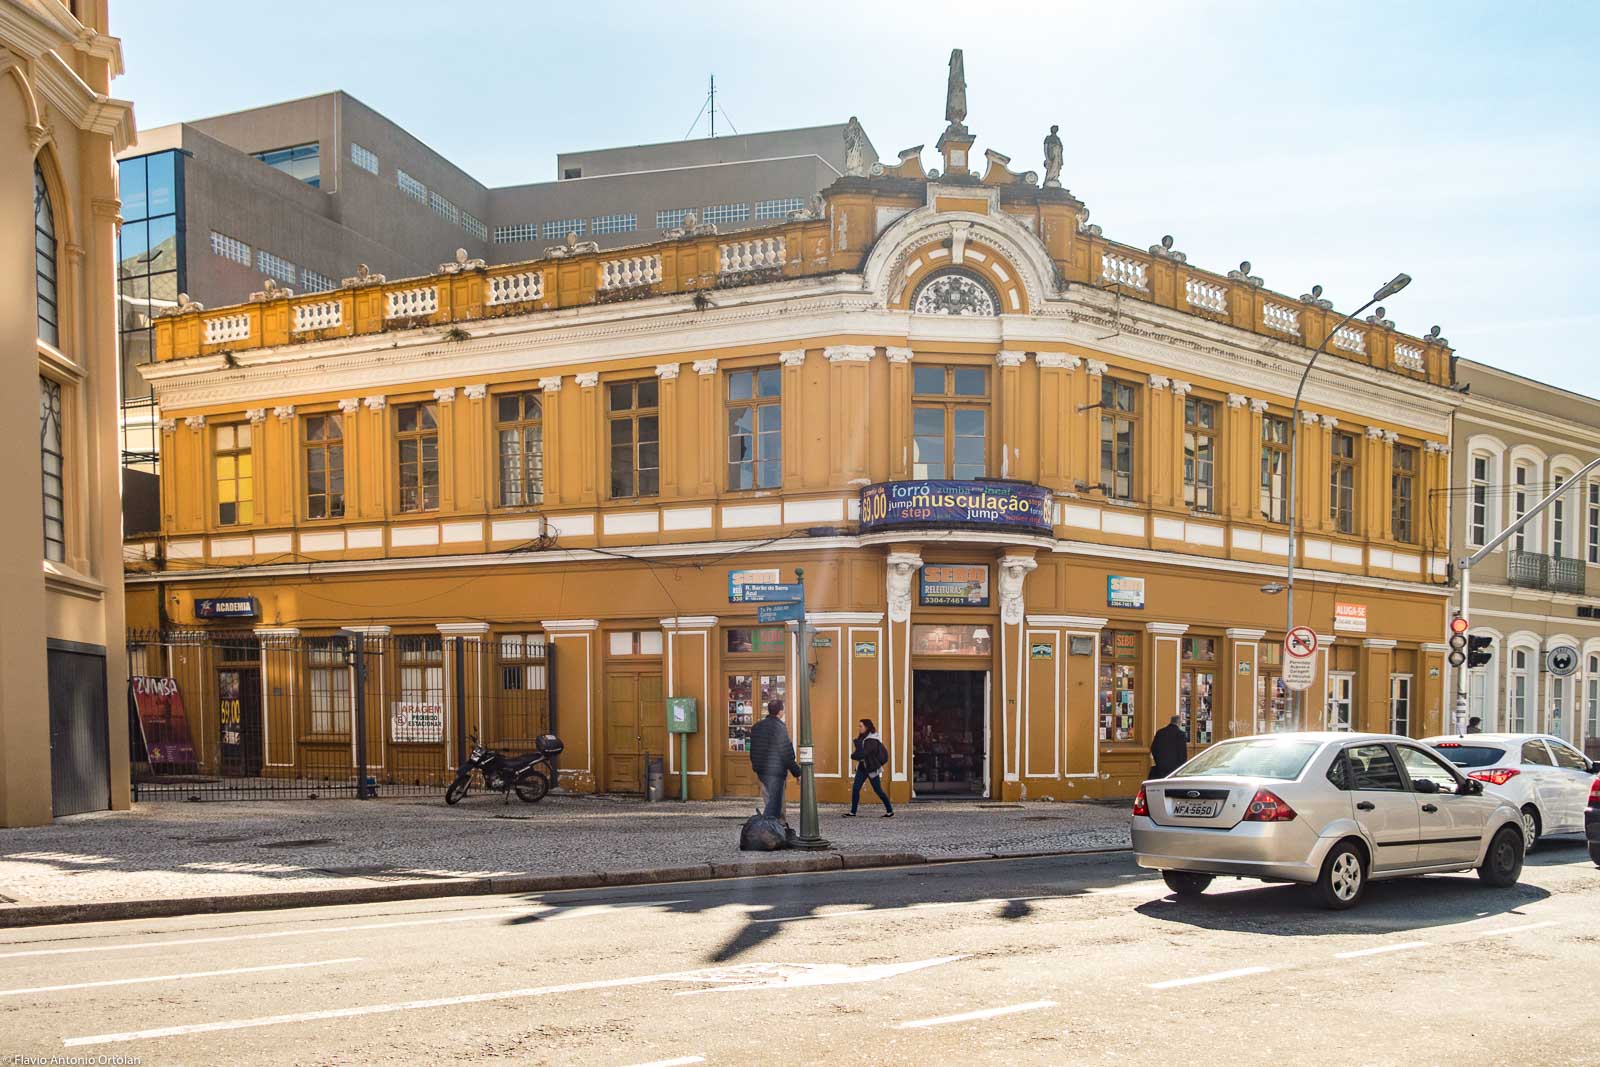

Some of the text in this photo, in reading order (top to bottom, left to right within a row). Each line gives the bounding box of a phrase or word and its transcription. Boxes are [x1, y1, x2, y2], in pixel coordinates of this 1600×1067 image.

[892, 482, 930, 498] forró
[937, 485, 971, 494] zumba
[863, 493, 887, 525] 69,00
[888, 500, 912, 511] jump
[912, 492, 1029, 514] musculação
[901, 507, 931, 519] step
[967, 507, 999, 520] jump
[924, 567, 986, 583] SEBO
[925, 585, 962, 594] RELEITURAS
[216, 601, 251, 612] ACADEMIA
[1336, 605, 1366, 617] ALUGA-SE
[136, 676, 178, 696] ZUMBA
[401, 705, 442, 714] ARAGEM
